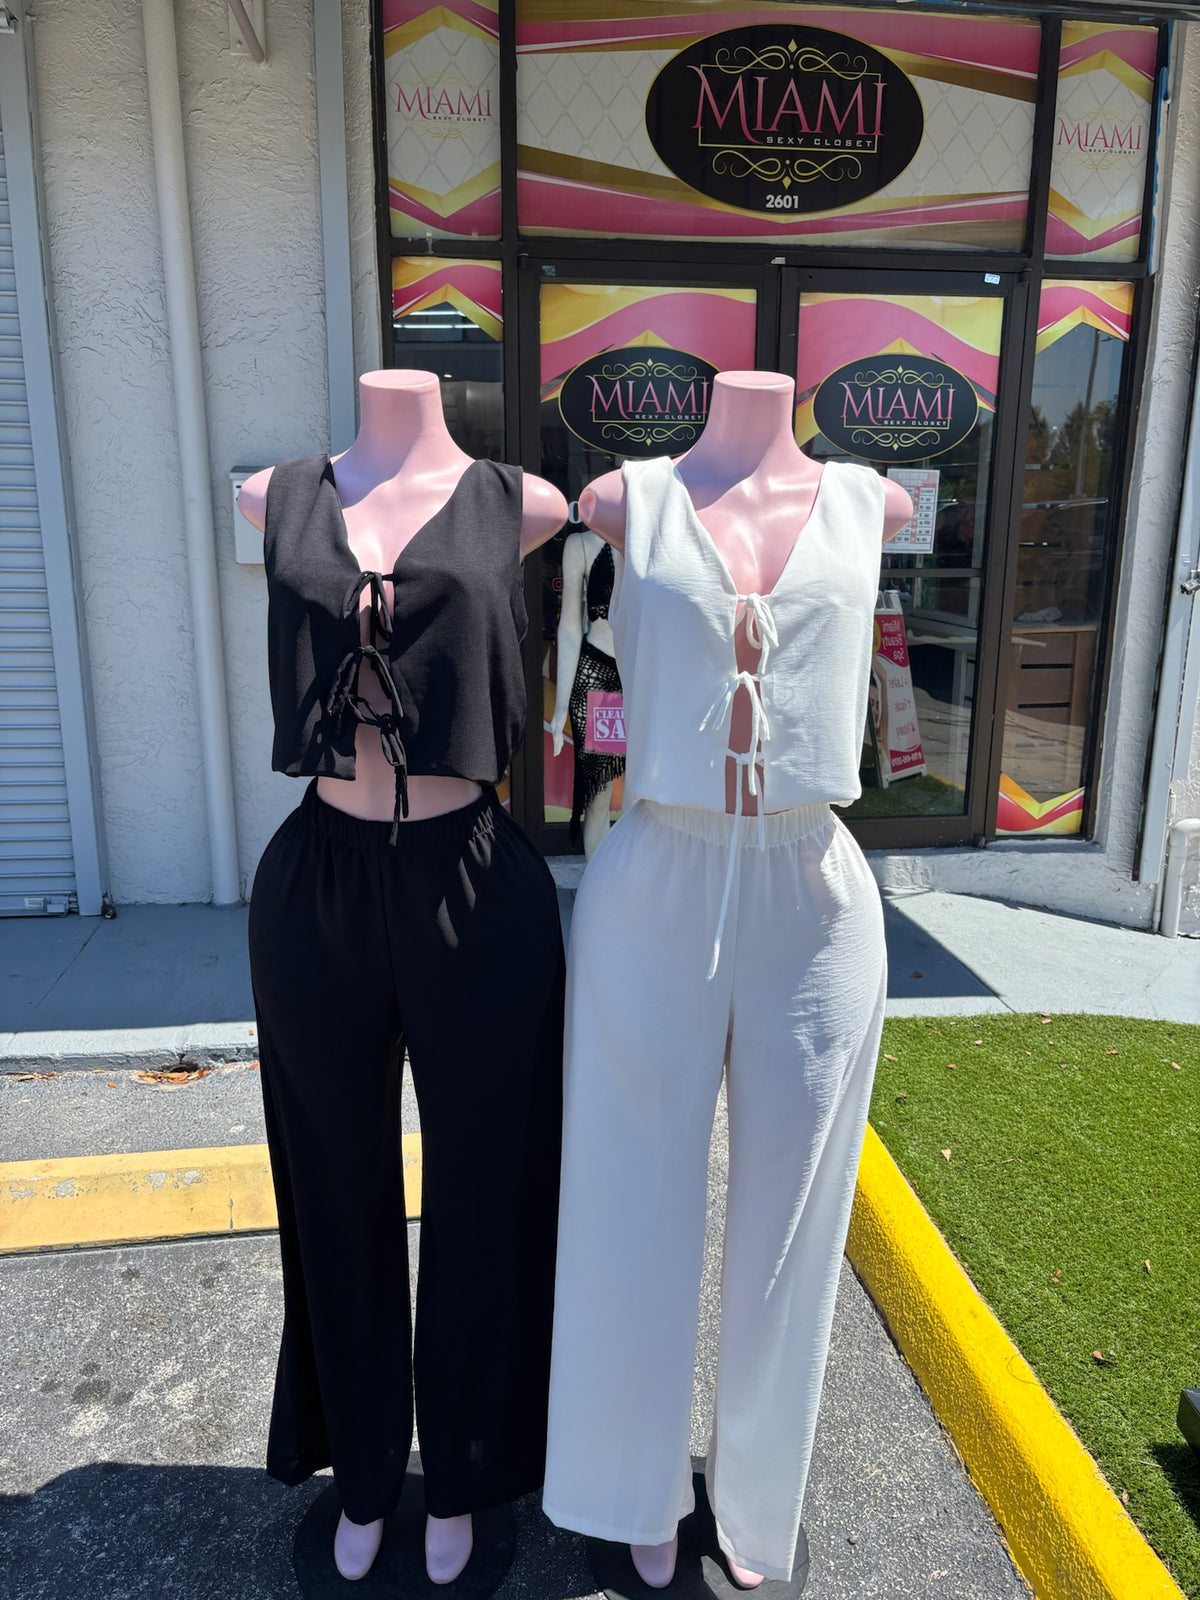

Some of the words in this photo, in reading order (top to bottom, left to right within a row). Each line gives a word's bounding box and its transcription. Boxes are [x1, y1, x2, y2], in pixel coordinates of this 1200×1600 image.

[393, 81, 492, 120] MIAMI
[686, 65, 888, 144] MIAMI
[766, 136, 804, 145] SEXY
[813, 137, 873, 148] CLOSET
[1056, 117, 1143, 152] MIAMI
[765, 194, 799, 209] 2601
[585, 375, 711, 420] MIAMI
[838, 382, 957, 426] MIAMI
